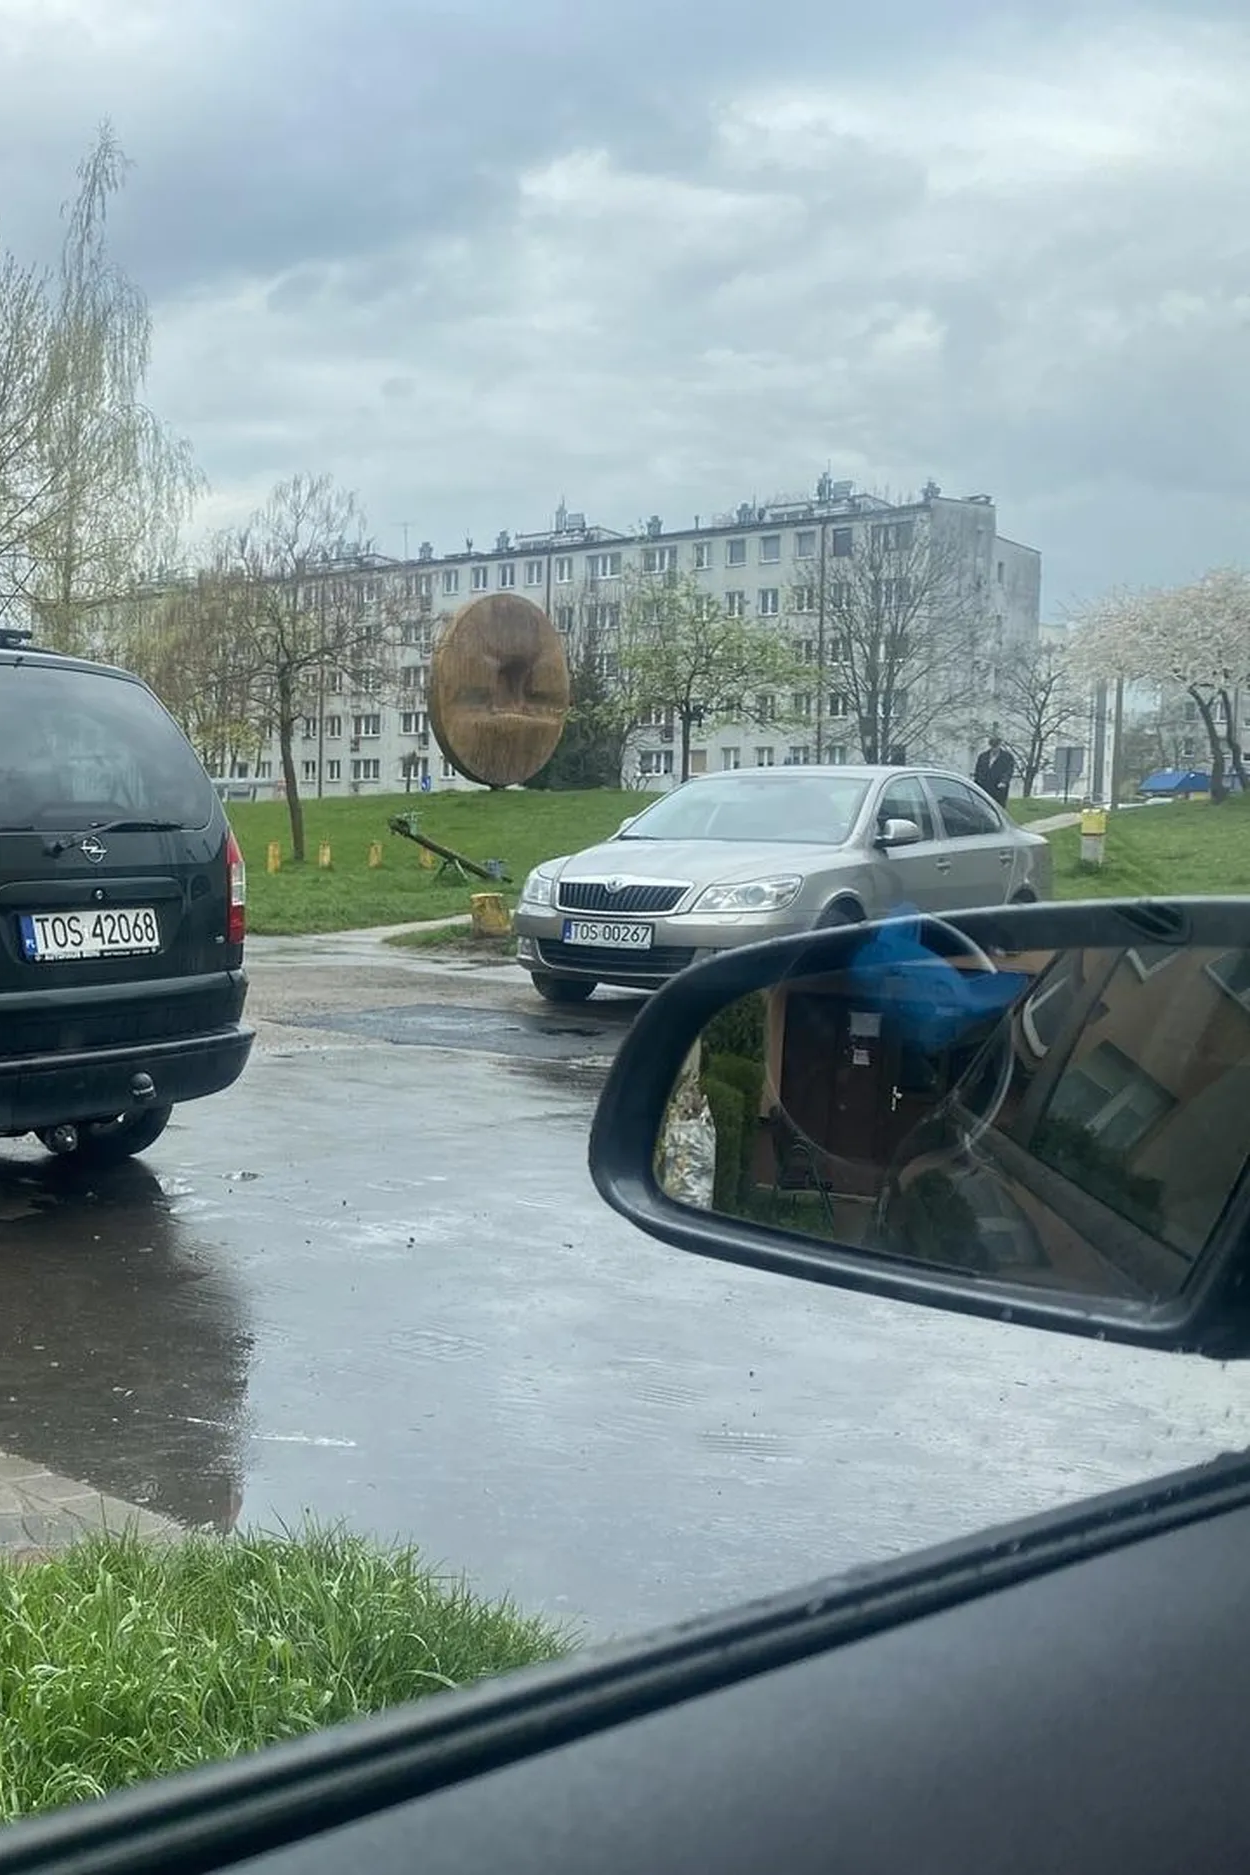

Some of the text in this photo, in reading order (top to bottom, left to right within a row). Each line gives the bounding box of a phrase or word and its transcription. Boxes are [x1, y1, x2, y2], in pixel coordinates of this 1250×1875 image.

[35, 912, 156, 949] TOS 42068
[573, 923, 650, 943] TOS 00267
